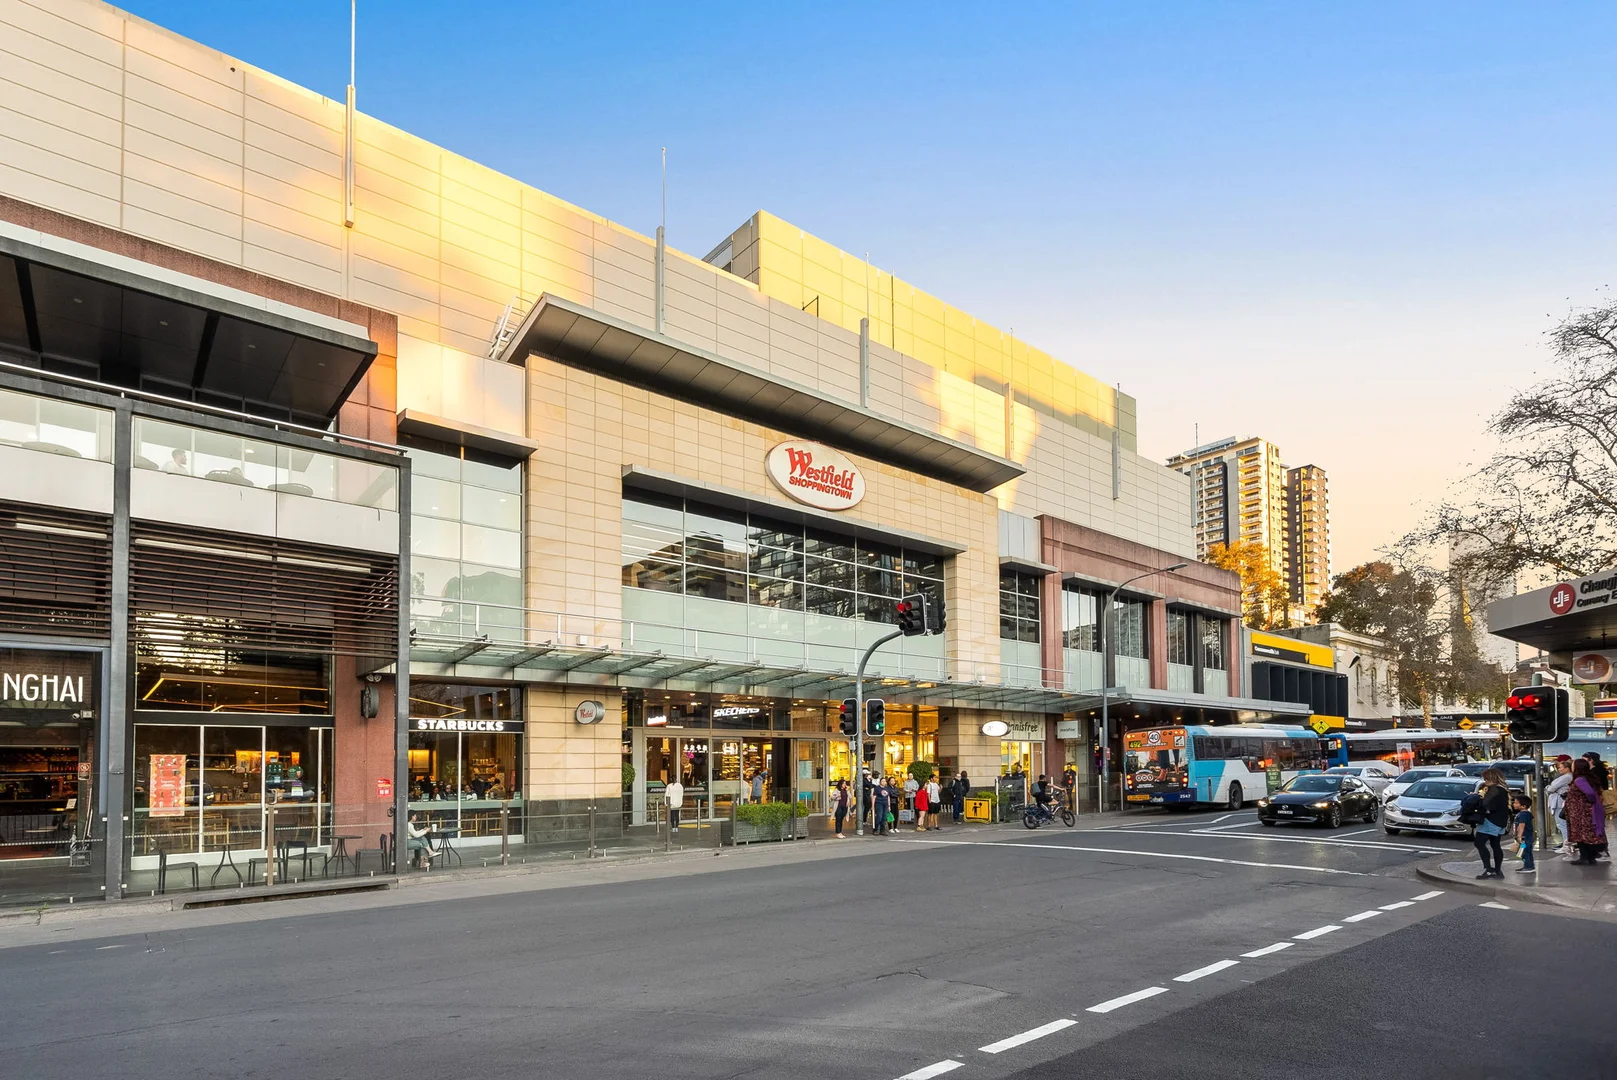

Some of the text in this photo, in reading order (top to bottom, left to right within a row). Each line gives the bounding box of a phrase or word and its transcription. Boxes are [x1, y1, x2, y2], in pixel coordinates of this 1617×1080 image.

[785, 447, 855, 491] Westfield
[788, 475, 852, 500] SHOPPINGTOWN
[3, 673, 84, 702] NGHAI
[713, 707, 760, 718] SKECHERS
[417, 719, 504, 732] STARBUCKS
[1149, 733, 1159, 741] 40
